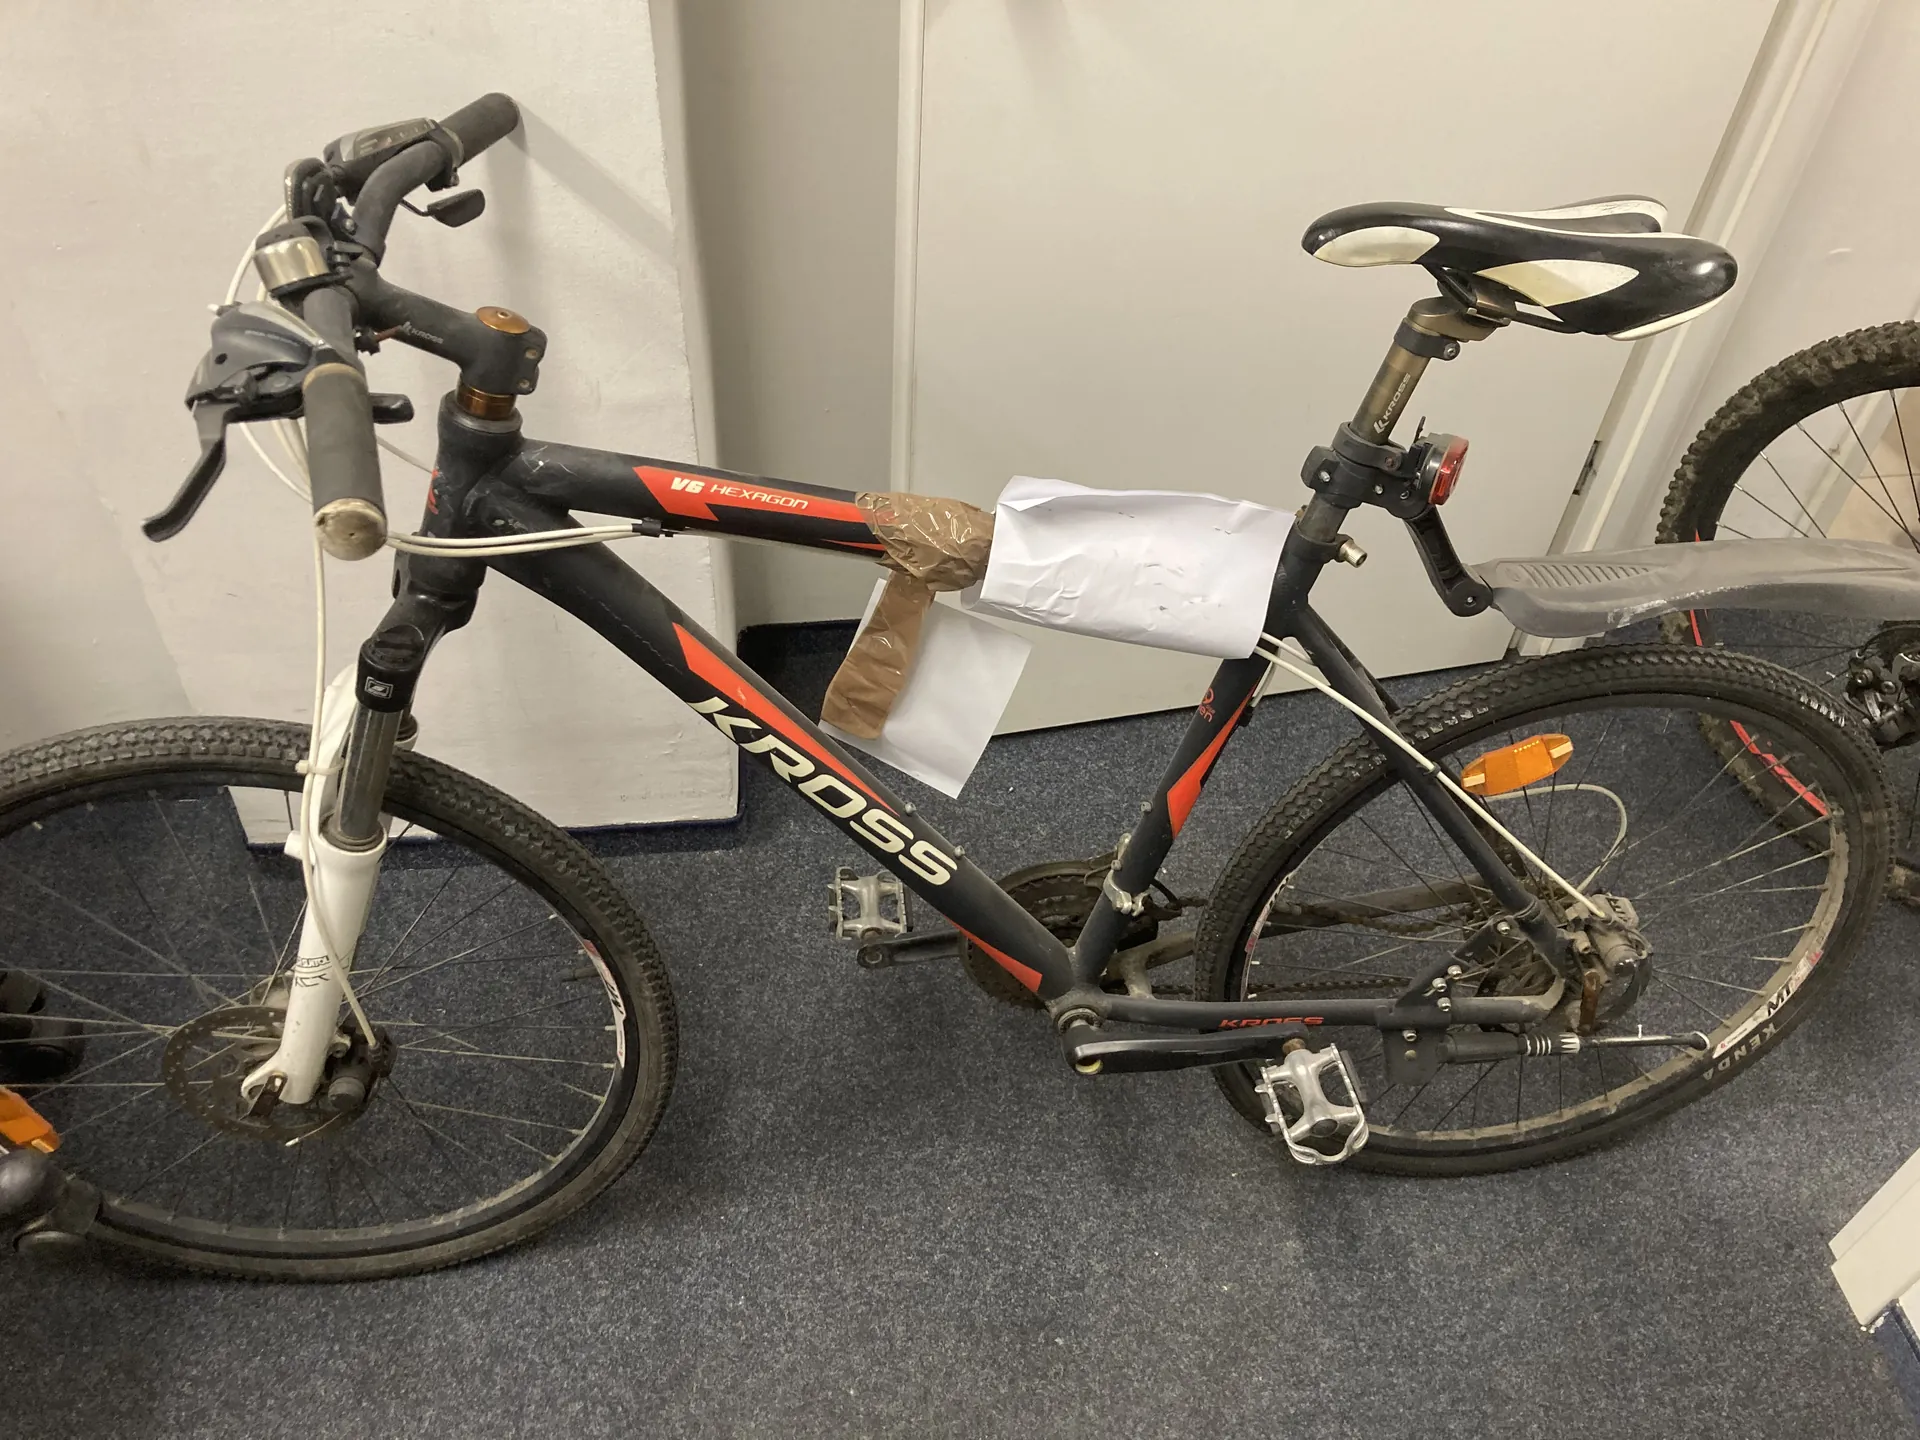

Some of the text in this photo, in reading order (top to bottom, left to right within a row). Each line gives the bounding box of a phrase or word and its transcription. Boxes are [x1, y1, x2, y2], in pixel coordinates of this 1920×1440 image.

[1383, 373, 1411, 420] KROSS
[670, 476, 808, 510] V6 HEXAGON
[685, 696, 958, 886] KROSS
[1703, 1022, 1776, 1081] KENDA
